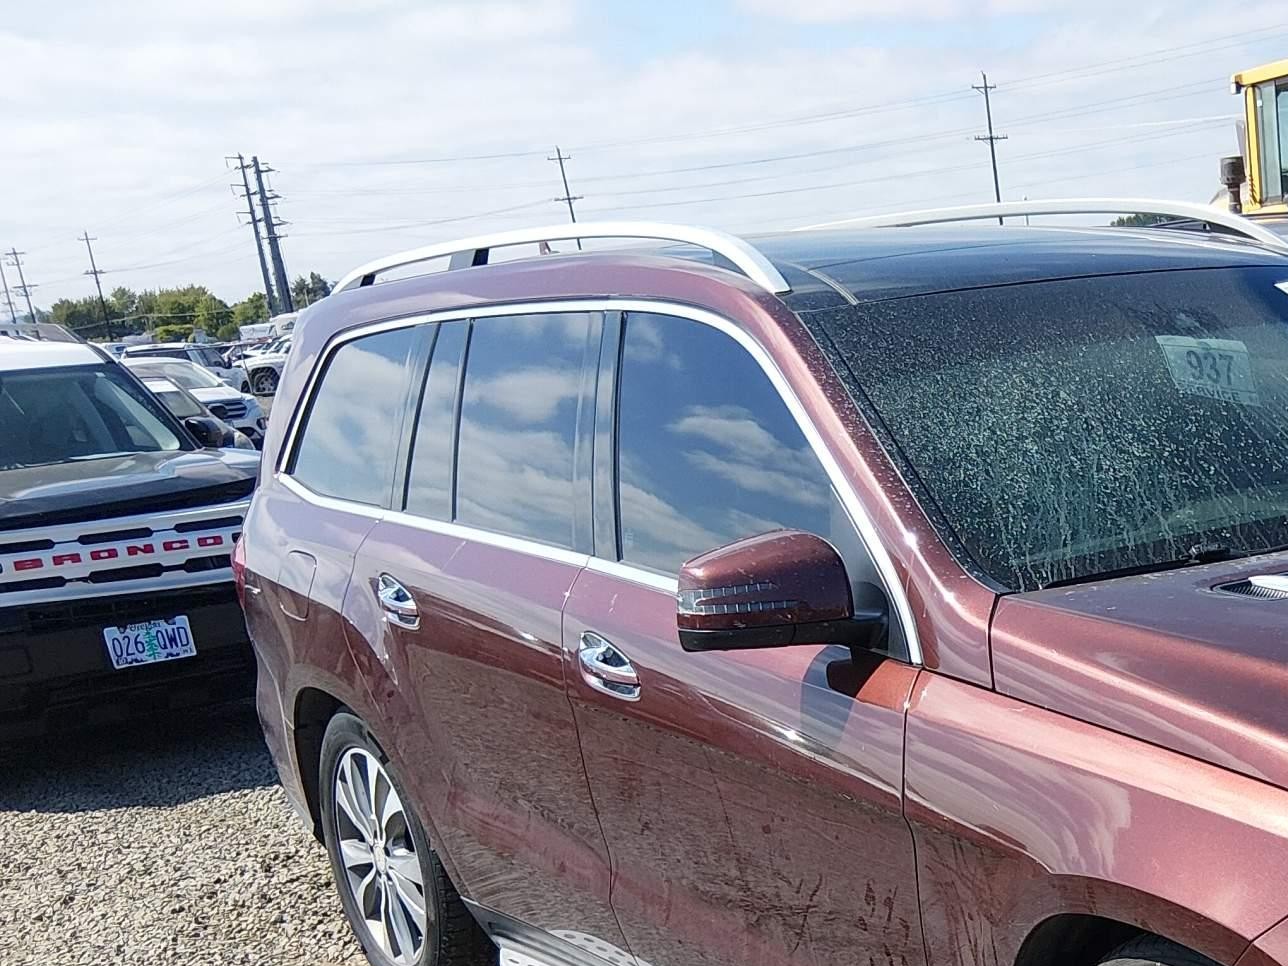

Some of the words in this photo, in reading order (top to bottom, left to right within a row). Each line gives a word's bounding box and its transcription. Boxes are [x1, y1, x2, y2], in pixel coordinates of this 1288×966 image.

[1185, 350, 1234, 386] 937
[13, 535, 223, 571] BRONCO
[111, 633, 146, 658] 026
[155, 626, 190, 650] QWD
